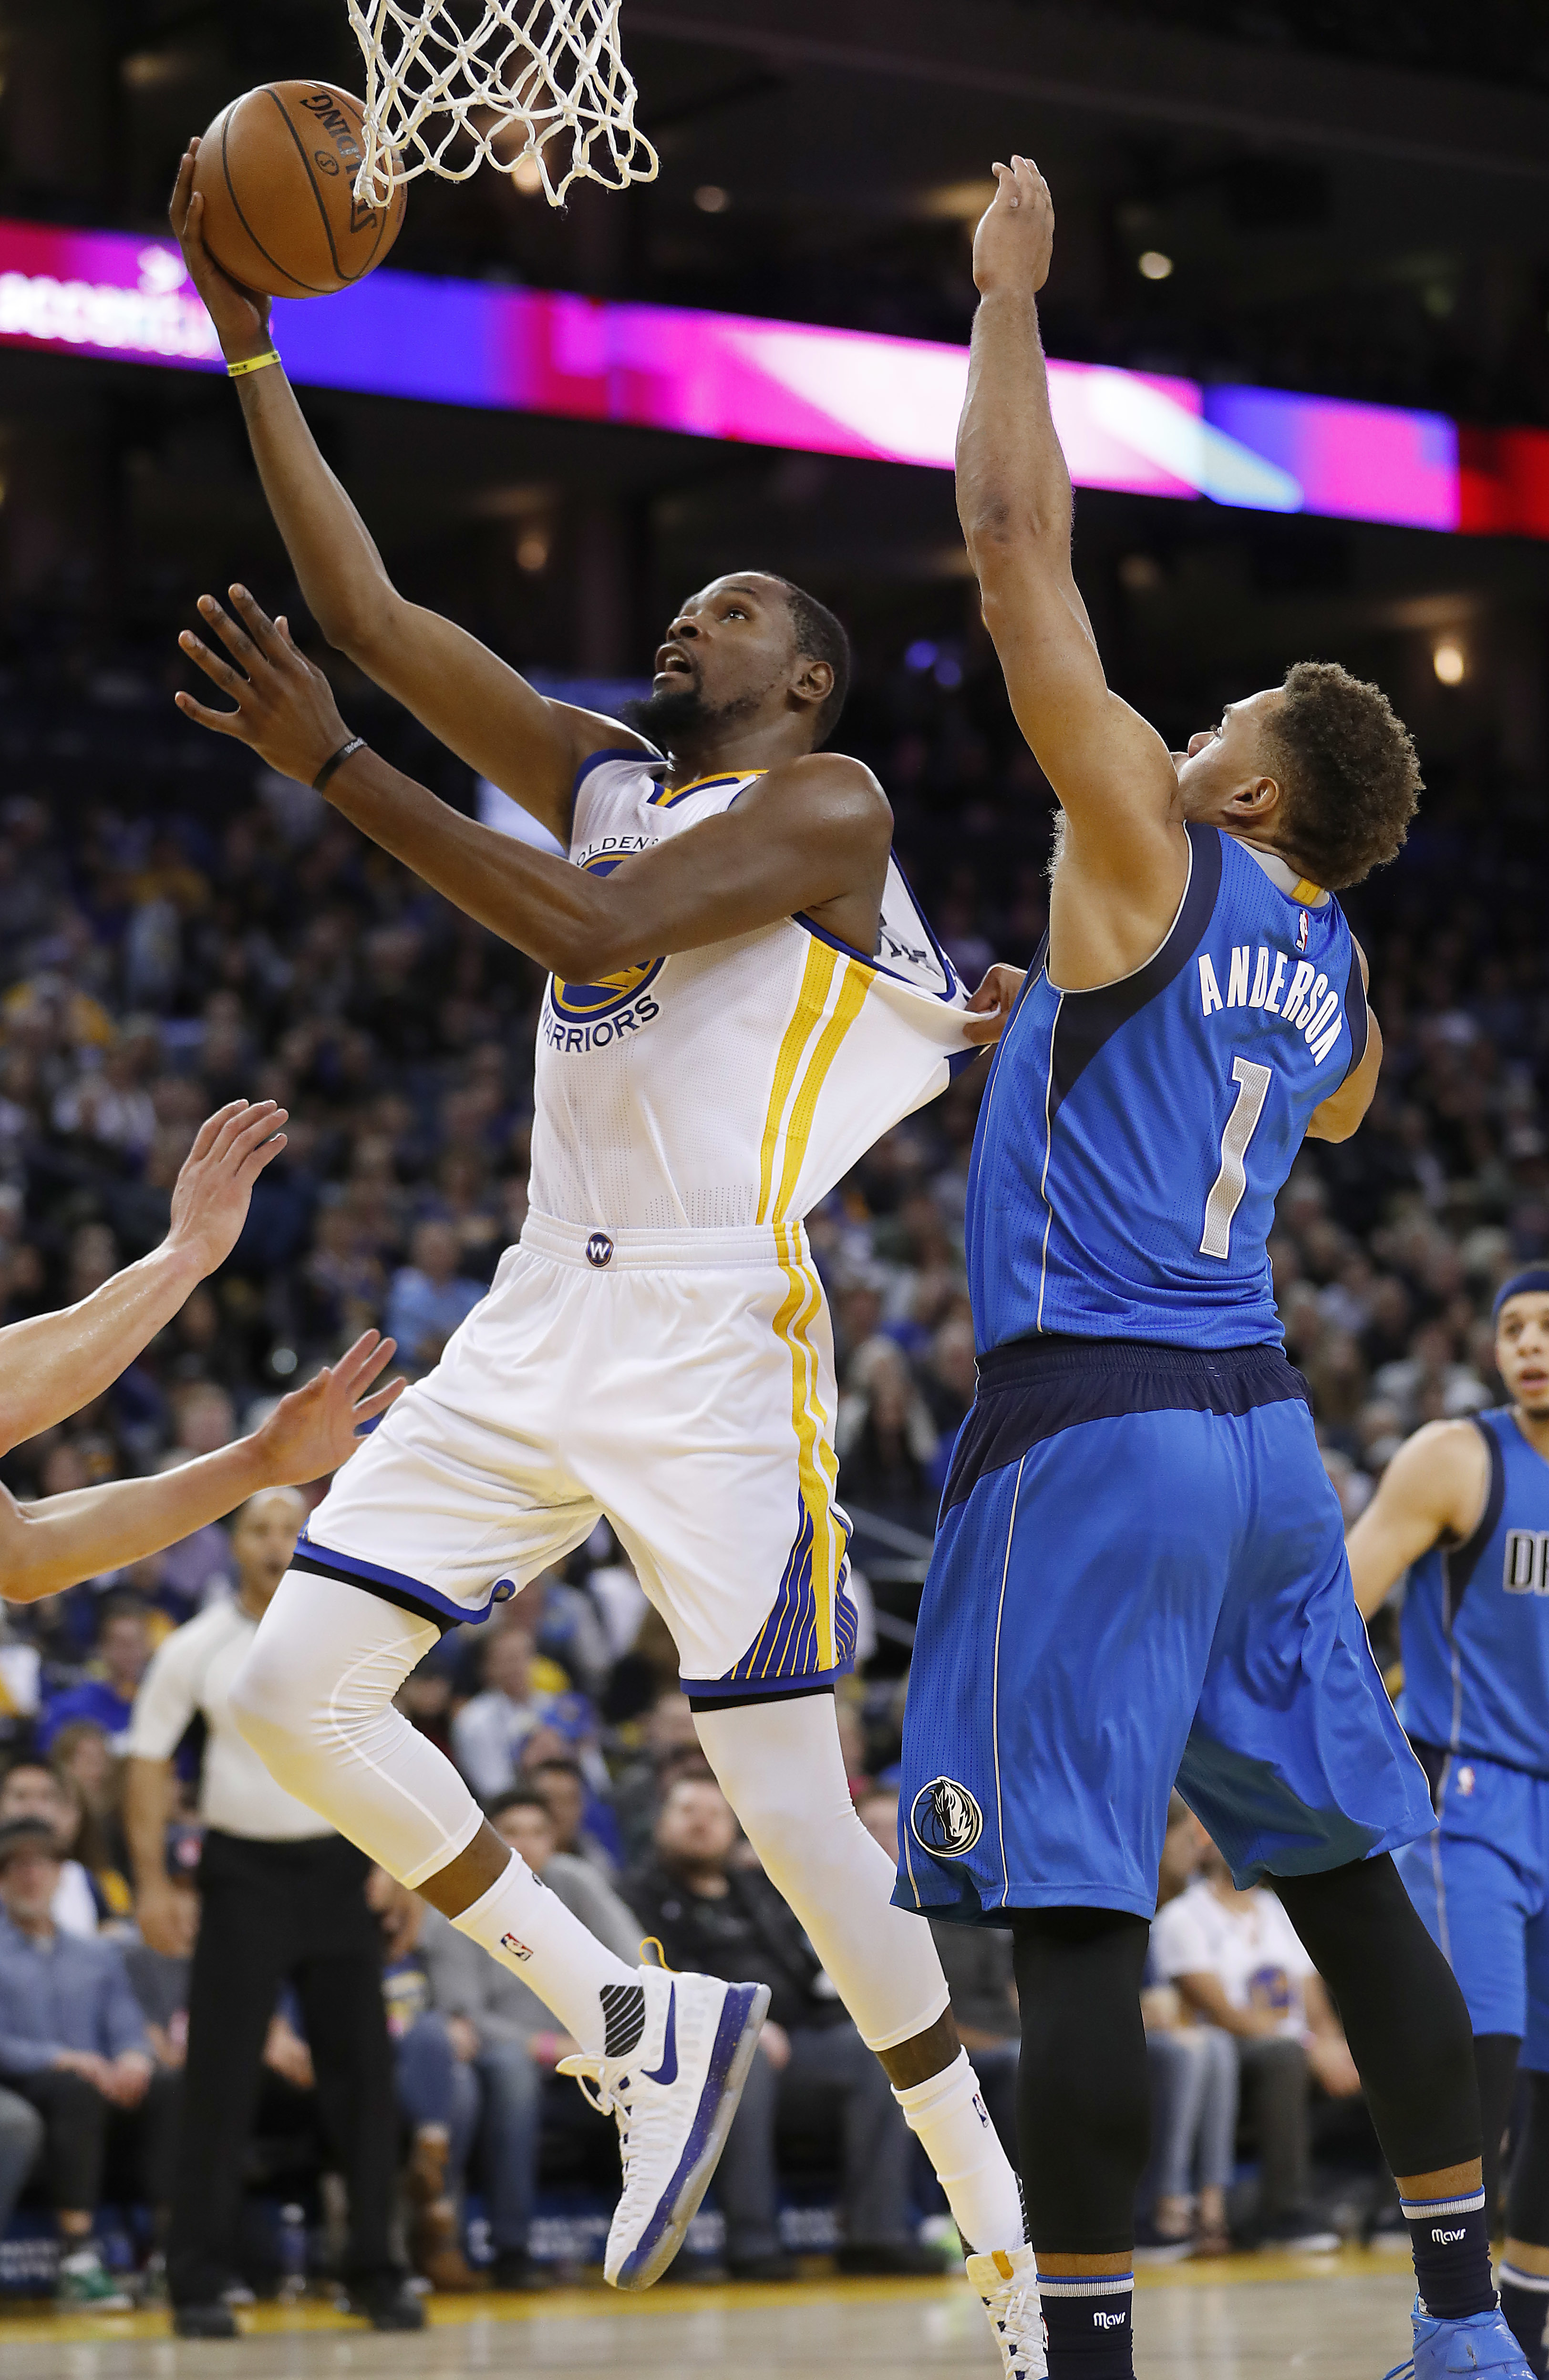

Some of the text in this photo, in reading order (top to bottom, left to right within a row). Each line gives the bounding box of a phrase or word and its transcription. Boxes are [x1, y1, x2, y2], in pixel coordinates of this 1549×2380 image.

[300, 92, 378, 233] SLDING
[577, 837, 649, 865] OLDEN
[1198, 945, 1342, 1067] ANDERSON
[1199, 1056, 1272, 1260] 1
[590, 1241, 610, 1259] W
[1432, 2228, 1466, 2245] Mavs
[1094, 2311, 1126, 2329] Mavs
